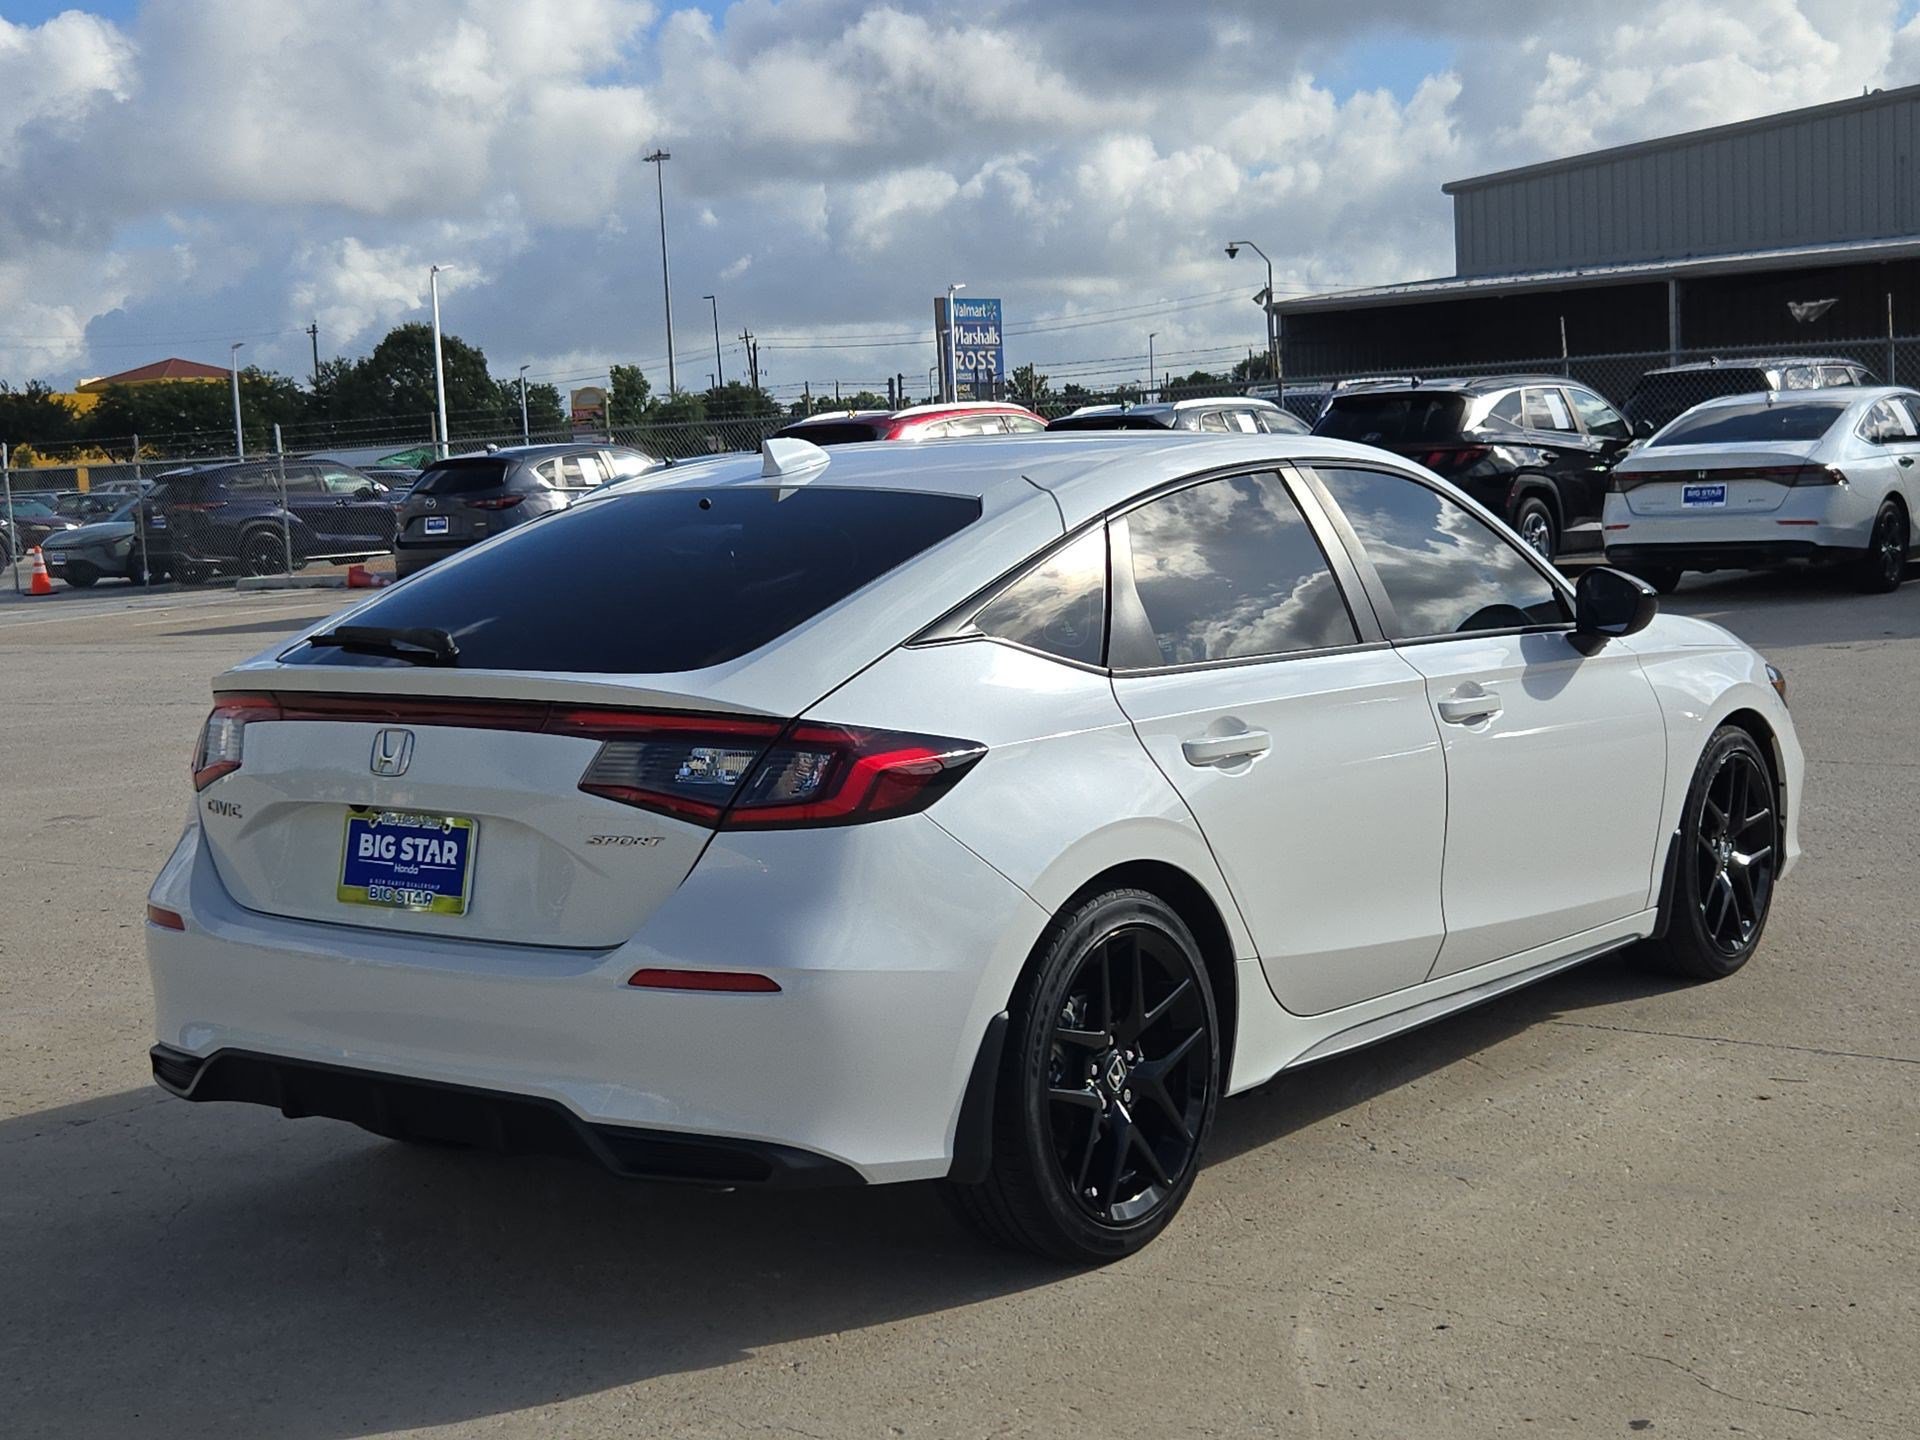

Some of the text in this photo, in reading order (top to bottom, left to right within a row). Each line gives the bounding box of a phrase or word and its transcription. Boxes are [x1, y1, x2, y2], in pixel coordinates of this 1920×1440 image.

[955, 325, 1000, 345] Marshalls
[956, 350, 997, 370] ROSS
[208, 799, 243, 818] CIVIC
[358, 833, 458, 865] BIG STAR
[585, 834, 666, 847] SPORT
[394, 864, 419, 875] Honda
[369, 884, 433, 906] BIG STAR
